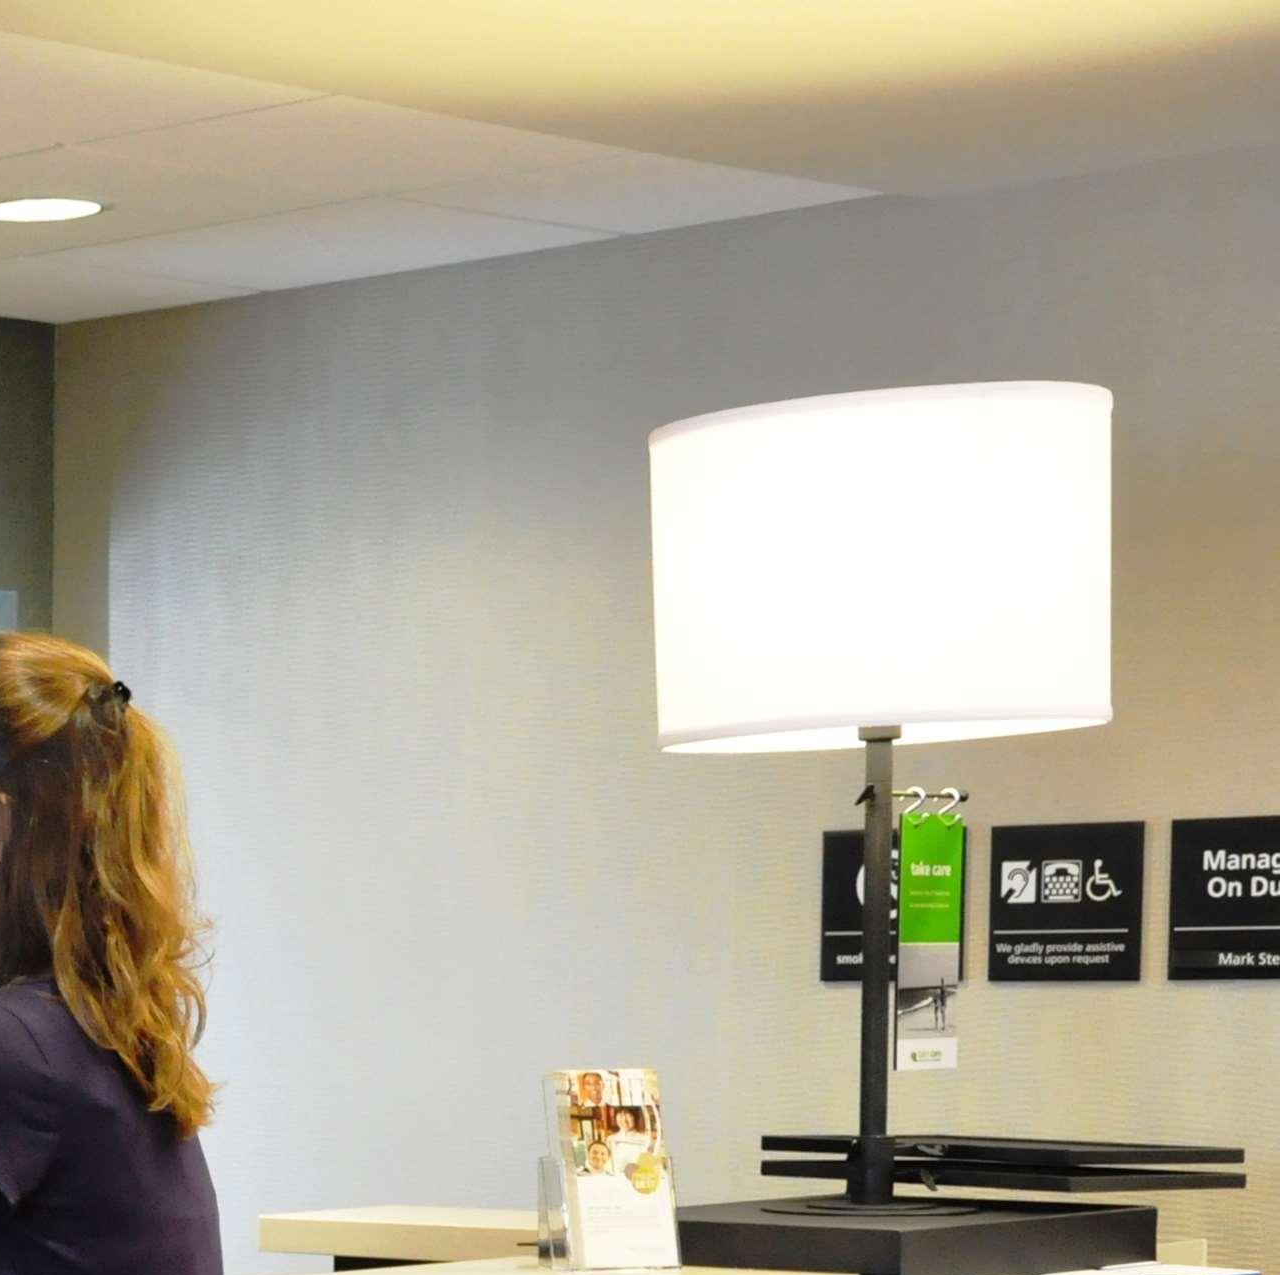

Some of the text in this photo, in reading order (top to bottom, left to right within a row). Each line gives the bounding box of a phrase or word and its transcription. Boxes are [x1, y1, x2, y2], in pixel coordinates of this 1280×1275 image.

[1206, 876, 1243, 898] On
[995, 941, 1125, 955] We gladly provide assistive
[836, 951, 863, 965] smo
[1007, 954, 1109, 966] devices upon request
[1218, 951, 1255, 966] Mark
